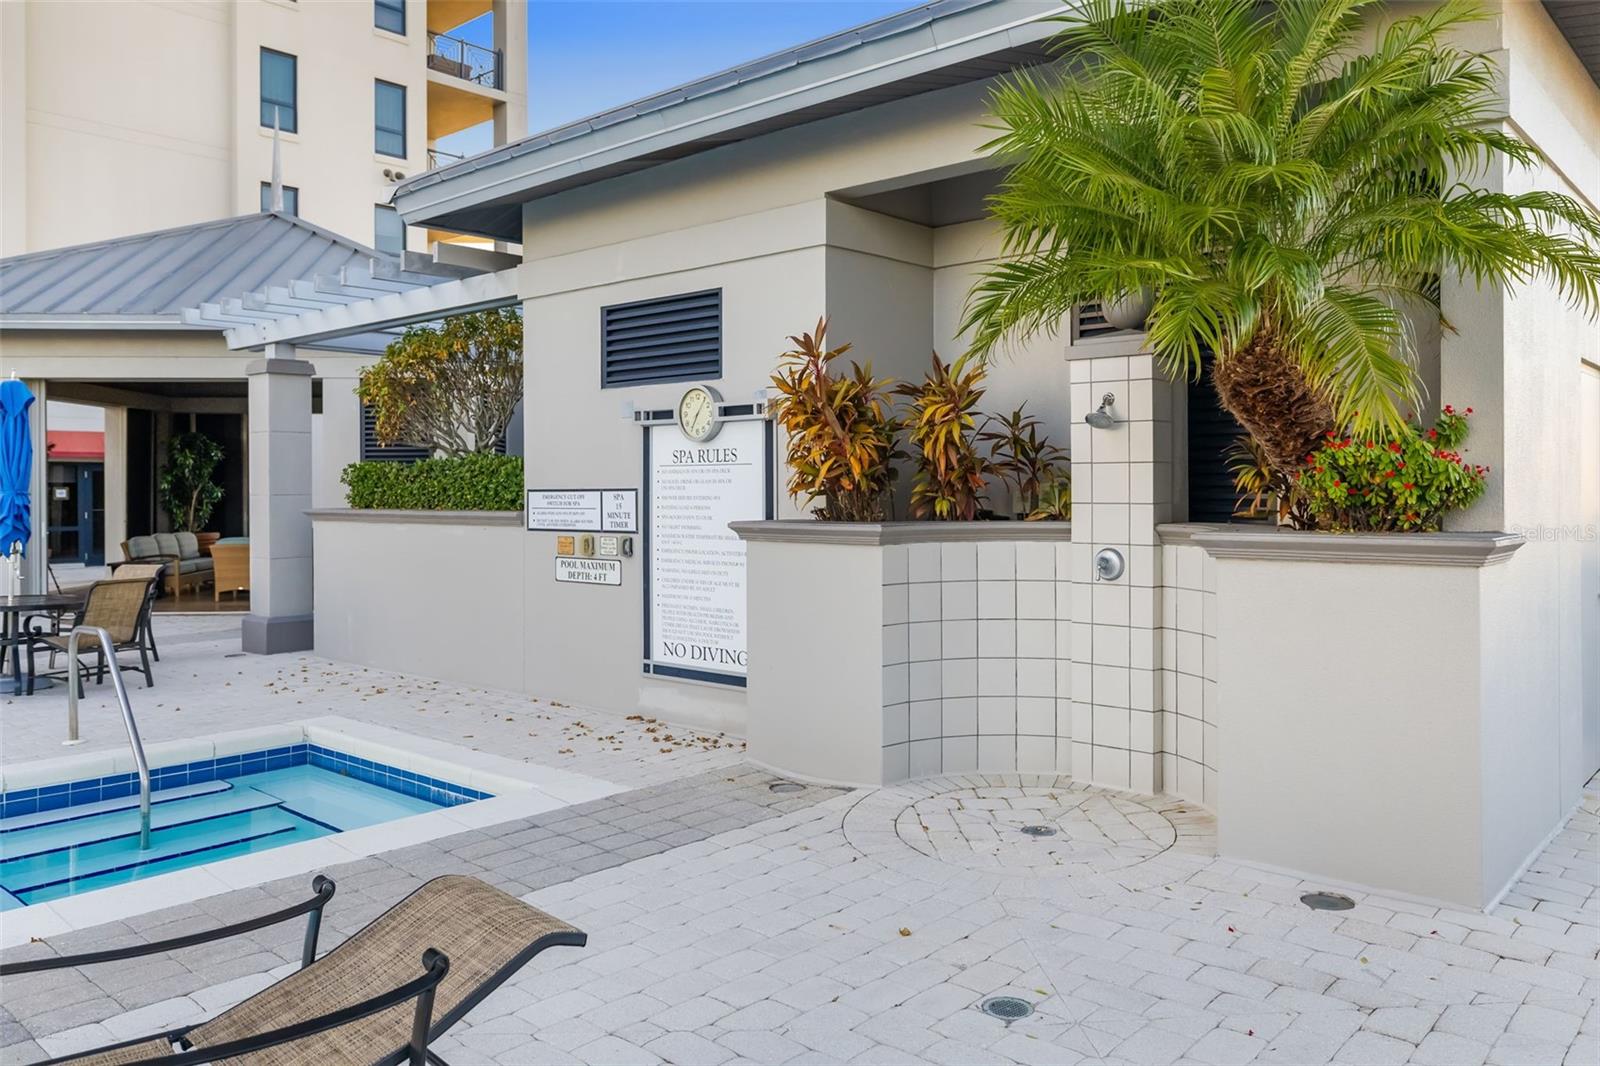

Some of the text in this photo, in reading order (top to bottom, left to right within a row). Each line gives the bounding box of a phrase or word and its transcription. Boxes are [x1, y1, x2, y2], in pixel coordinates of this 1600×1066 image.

[672, 448, 738, 464] SPA RULES
[613, 493, 625, 501] SPA
[607, 511, 631, 520] MINUTE
[609, 521, 629, 529] TIMER
[560, 560, 616, 571] POOL MAXIMUM
[568, 571, 593, 581] DEPTH:
[598, 573, 608, 582] FT
[663, 641, 748, 667] NO DIVING
